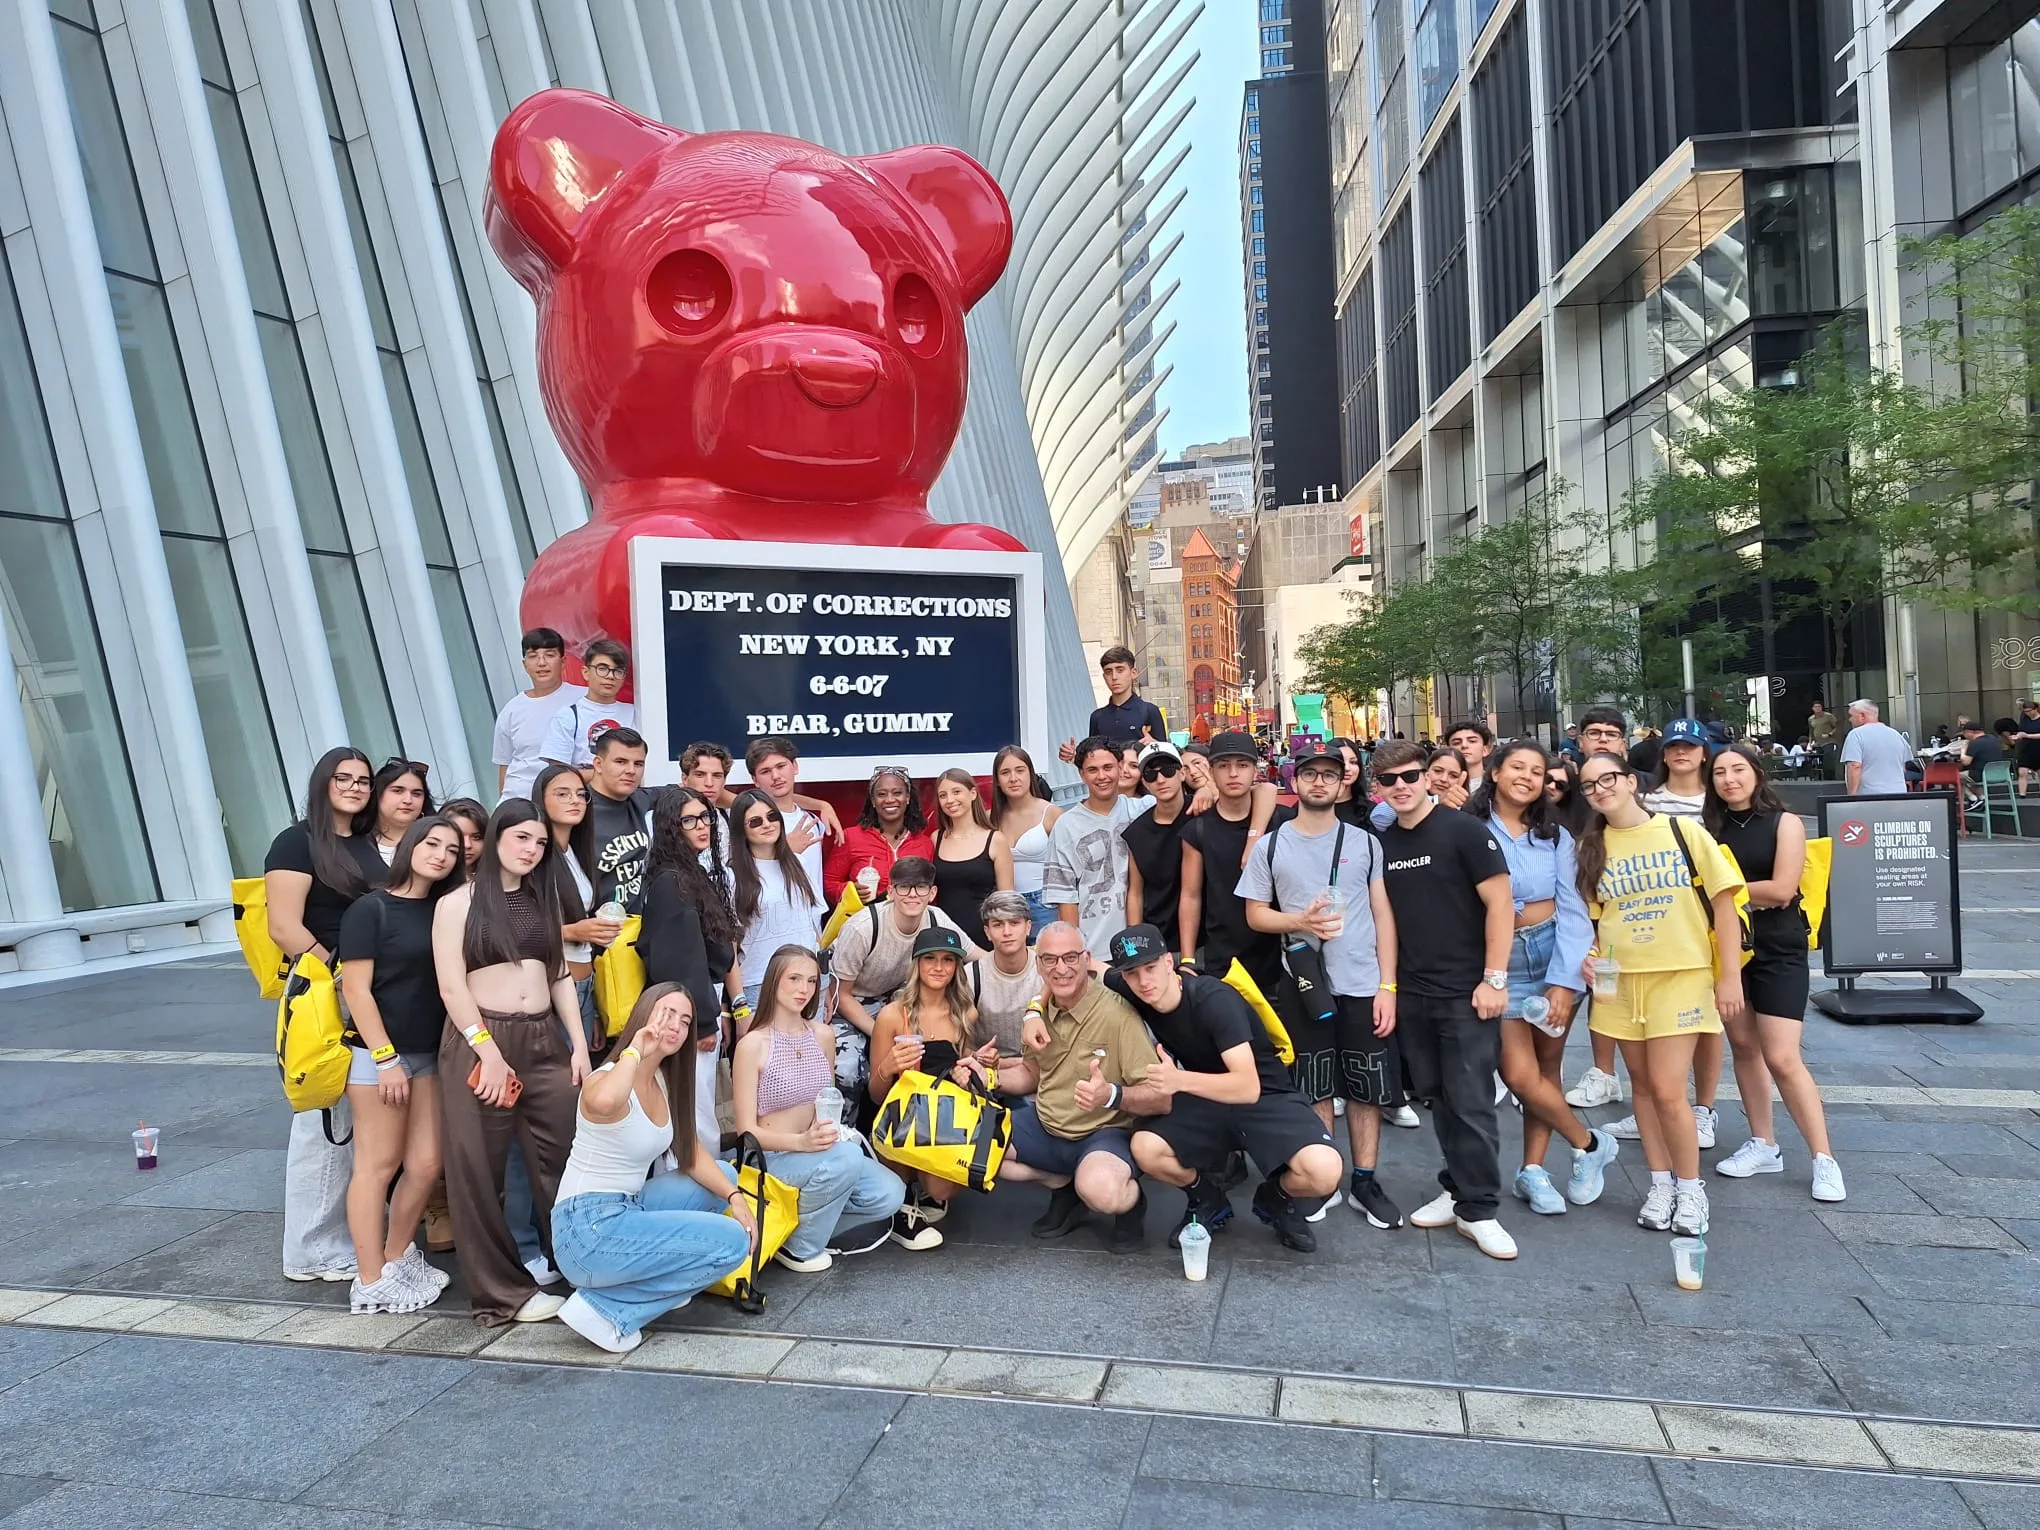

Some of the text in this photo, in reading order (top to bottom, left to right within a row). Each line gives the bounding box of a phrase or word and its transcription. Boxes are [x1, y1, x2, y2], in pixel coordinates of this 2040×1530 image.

[812, 594, 1011, 618] CORRECTIONS
[739, 634, 954, 658] NEW YORK, NY
[809, 674, 889, 698] 6-6-07
[746, 712, 954, 737] BEAR, GUMMY
[1874, 820, 1931, 834] CLIMBING ON
[1874, 834, 1928, 847] SCULPTURES
[597, 830, 649, 873] ESSENTIA
[1875, 846, 1939, 860] IS PROHIBITED.
[1388, 855, 1431, 871] MONCLER
[1604, 848, 1688, 878] Natura
[1889, 866, 1926, 874] designated
[1597, 862, 1691, 900] Attitude
[1618, 895, 1674, 911] EASY DAYS
[1622, 910, 1667, 923] SOCIETY
